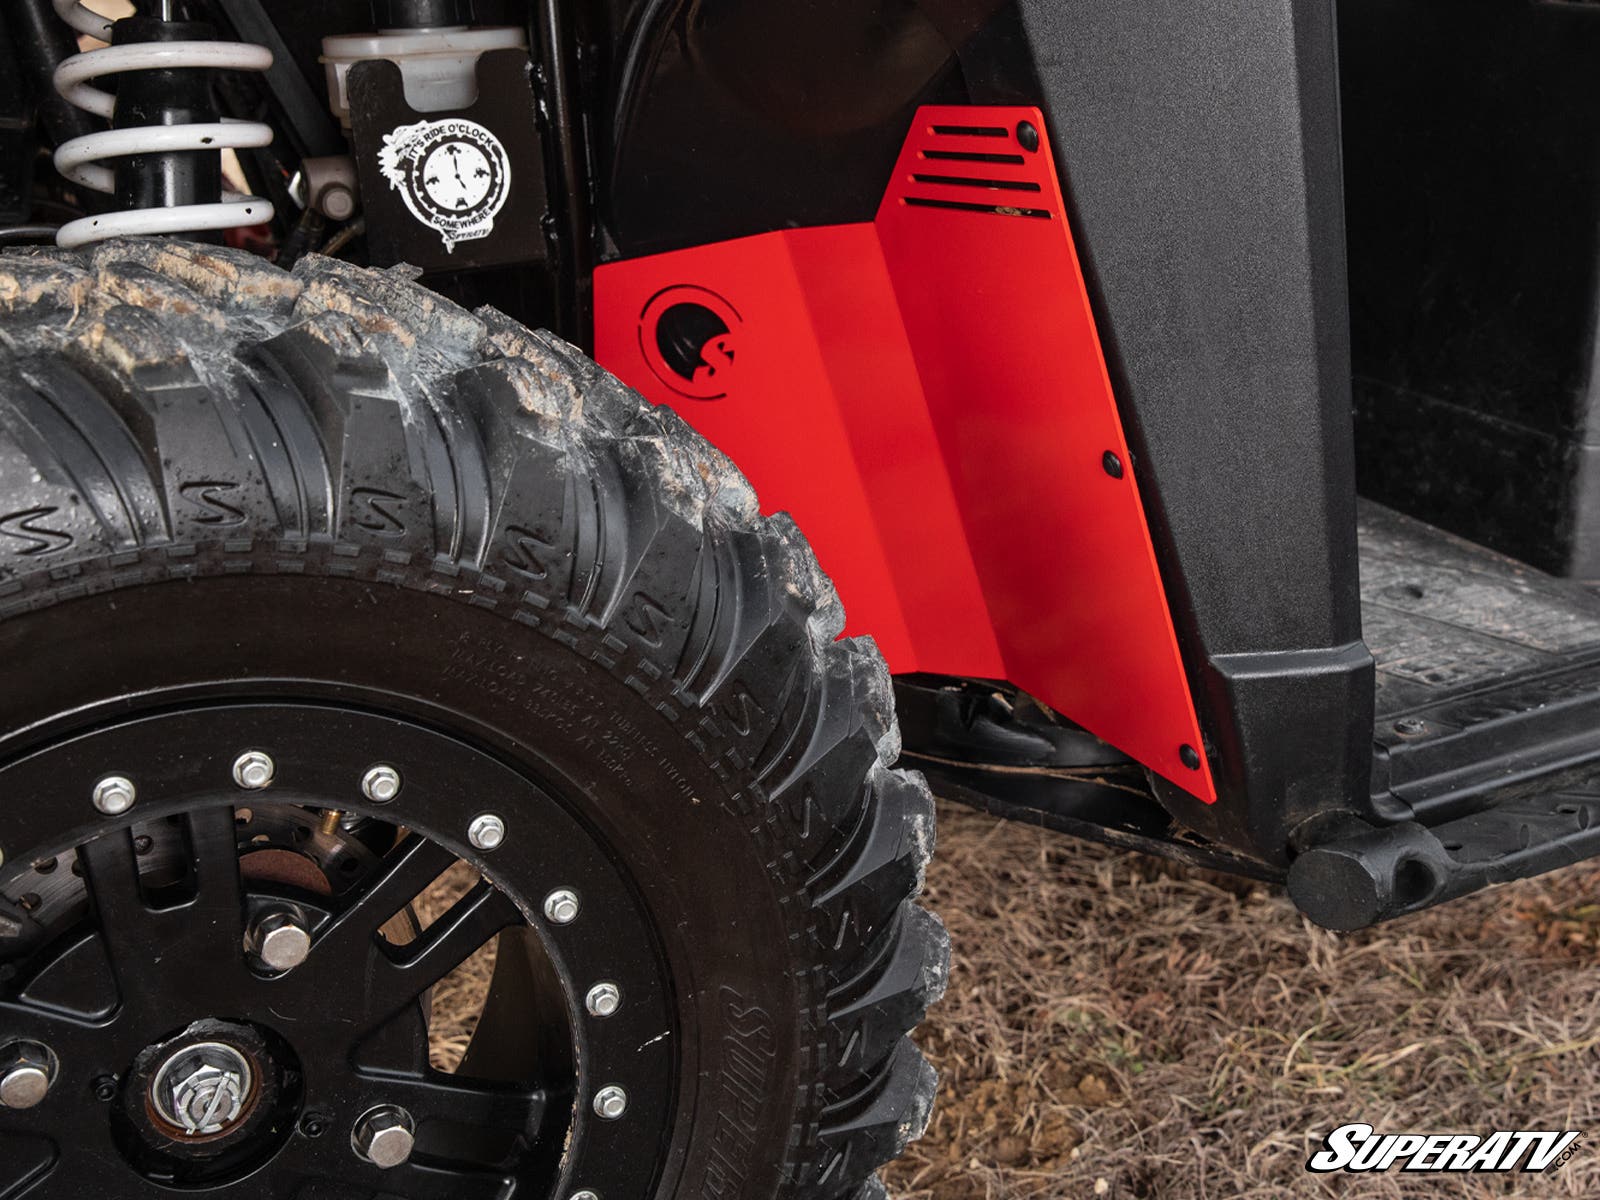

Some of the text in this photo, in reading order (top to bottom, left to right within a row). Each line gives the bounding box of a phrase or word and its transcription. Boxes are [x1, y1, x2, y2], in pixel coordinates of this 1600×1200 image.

[407, 124, 496, 160] IT'S RIDE O'CLOCK
[433, 207, 490, 229] SOMEWHERE
